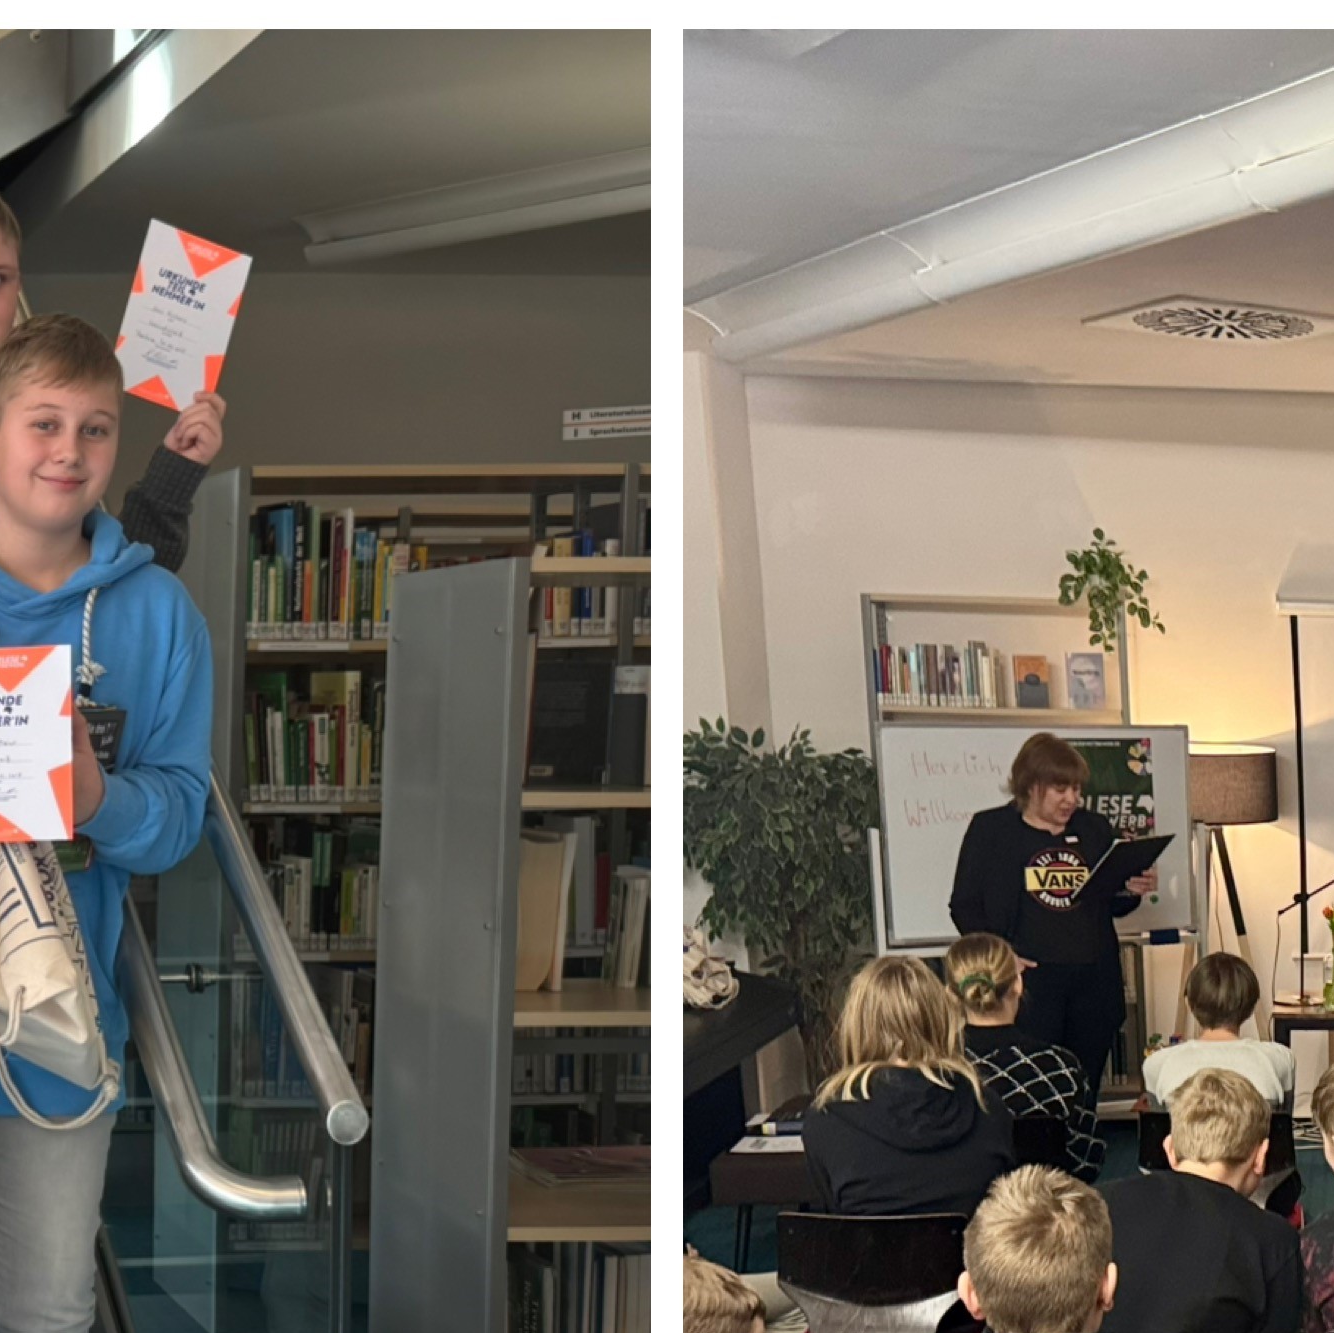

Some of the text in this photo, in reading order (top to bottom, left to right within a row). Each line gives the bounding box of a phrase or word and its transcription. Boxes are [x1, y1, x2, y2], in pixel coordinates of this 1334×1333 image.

[158, 266, 206, 294] URKUNDE
[167, 280, 187, 295] TEIL
[910, 751, 1003, 777] Herzlich
